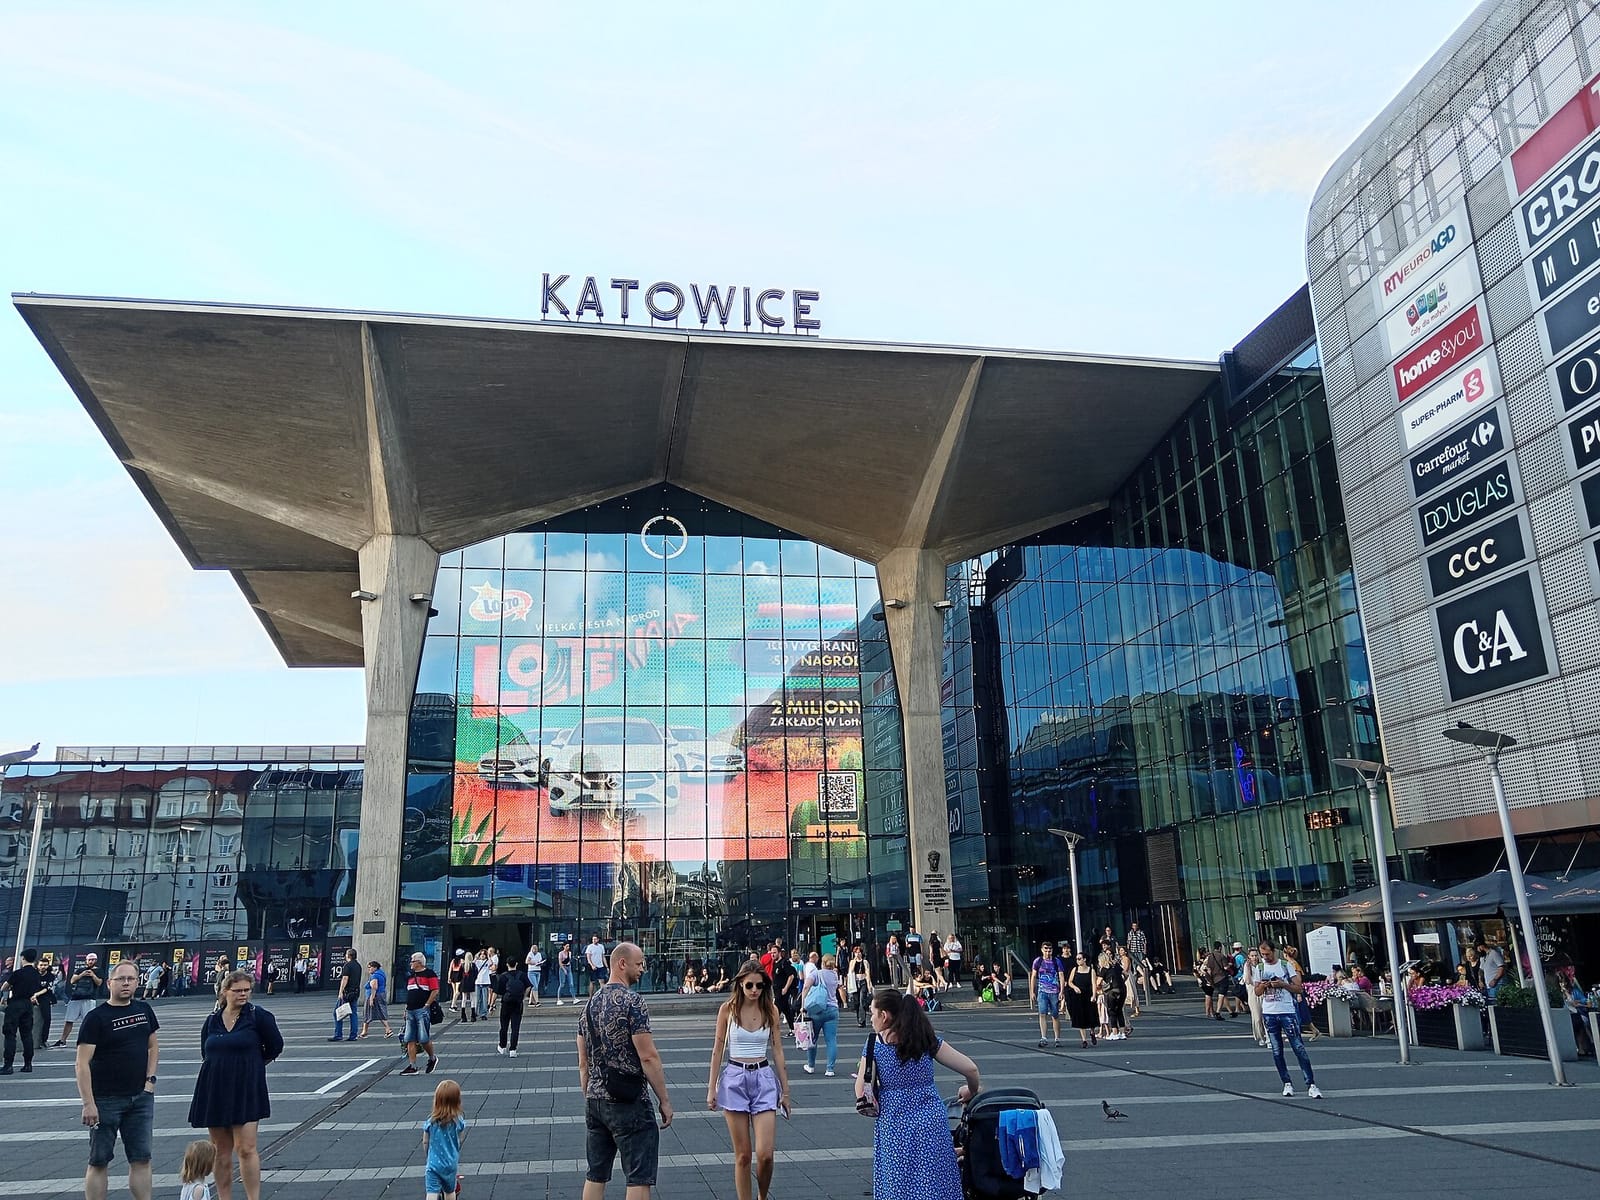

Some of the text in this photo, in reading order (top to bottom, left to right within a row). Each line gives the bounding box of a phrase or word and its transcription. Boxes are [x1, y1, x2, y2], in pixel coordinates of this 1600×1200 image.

[541, 273, 821, 329] KATOWICE
[1399, 321, 1476, 388] home&you
[1570, 350, 1600, 394] O
[1410, 389, 1465, 430] SUPER-PHARM
[1416, 439, 1468, 477] Carrefour
[1442, 450, 1471, 475] market
[1424, 473, 1509, 536] DOUGLAS
[1448, 538, 1498, 578] CCC
[579, 619, 614, 630] FESTA
[1452, 608, 1528, 675] C&A
[772, 700, 784, 715] 2
[816, 828, 850, 840] loto.pl
